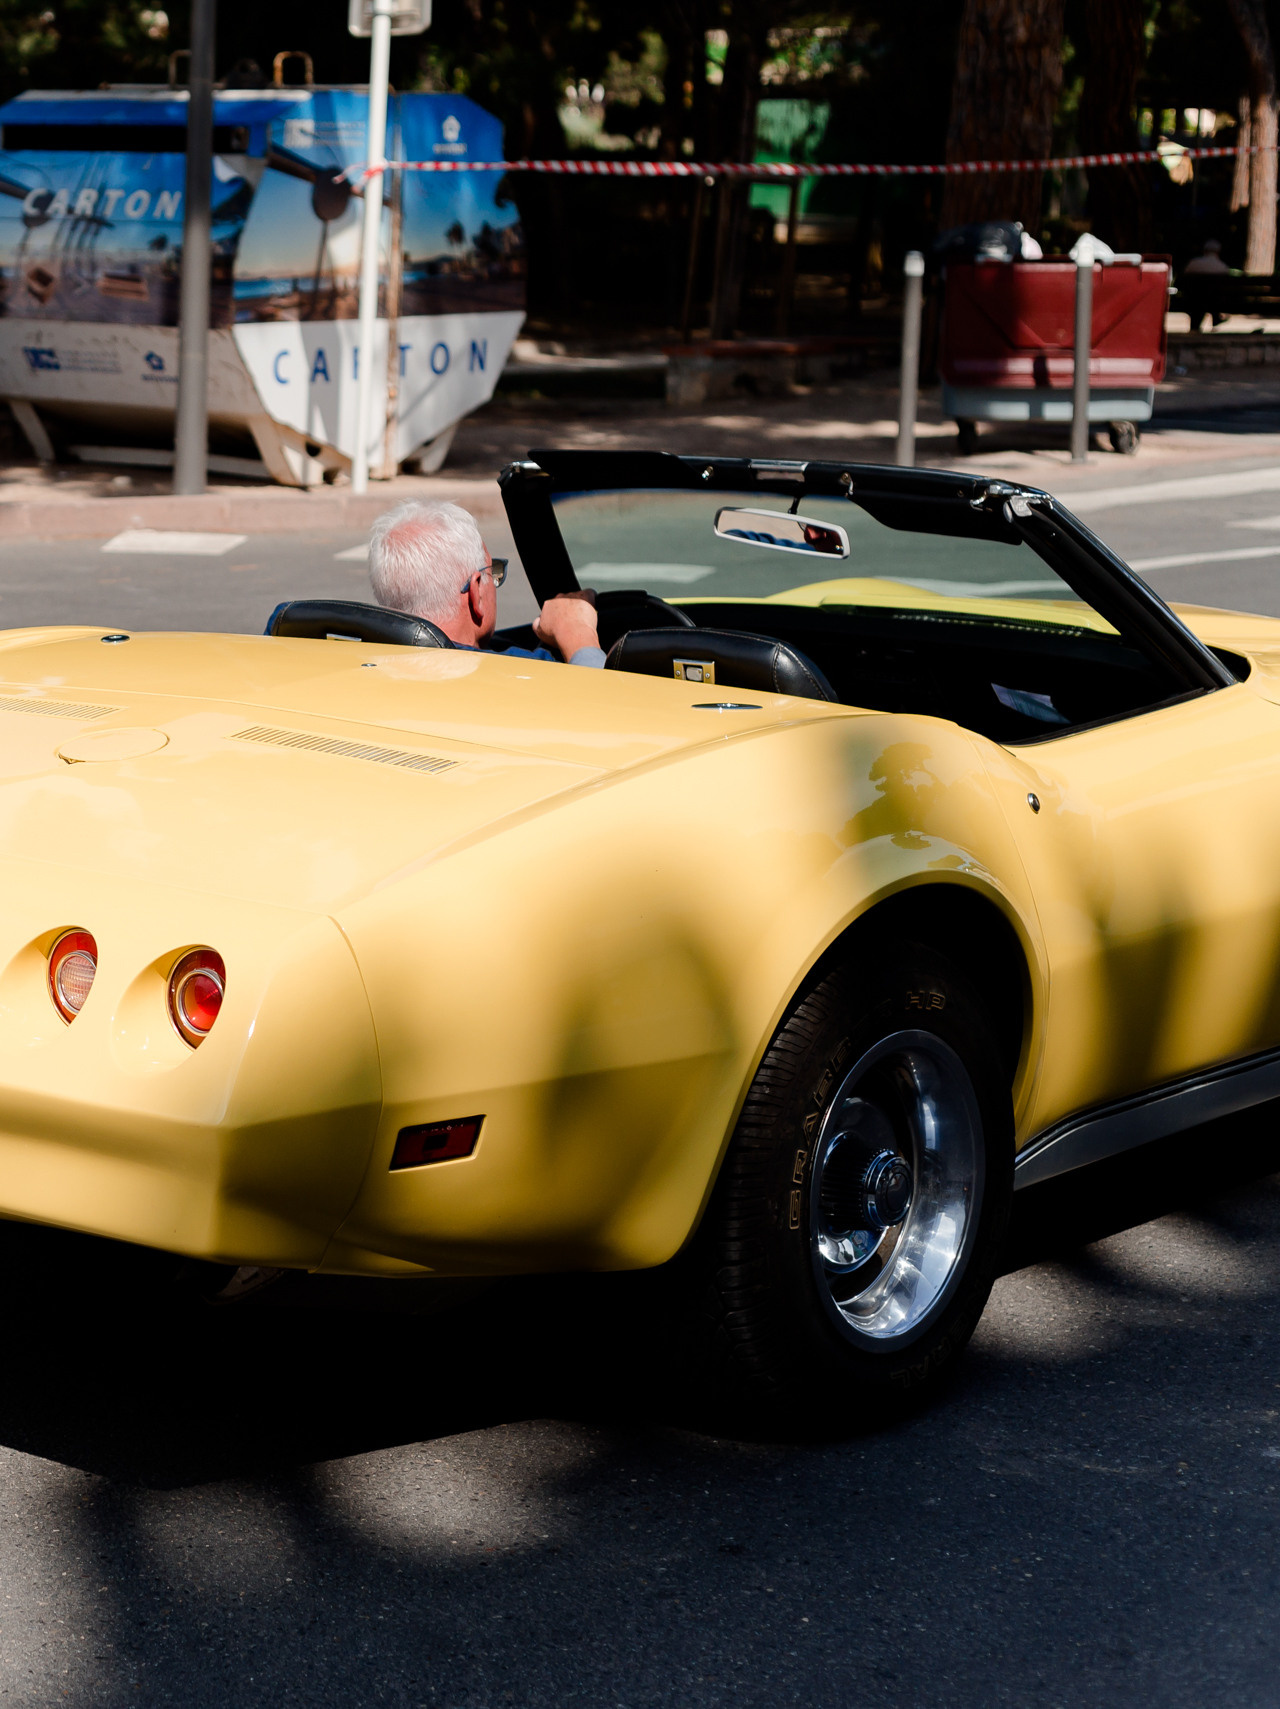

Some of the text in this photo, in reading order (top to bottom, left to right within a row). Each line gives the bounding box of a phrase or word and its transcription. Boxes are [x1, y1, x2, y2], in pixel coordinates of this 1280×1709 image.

[23, 187, 182, 220] CARTON
[273, 339, 488, 384] CATON
[904, 989, 946, 1011] HP
